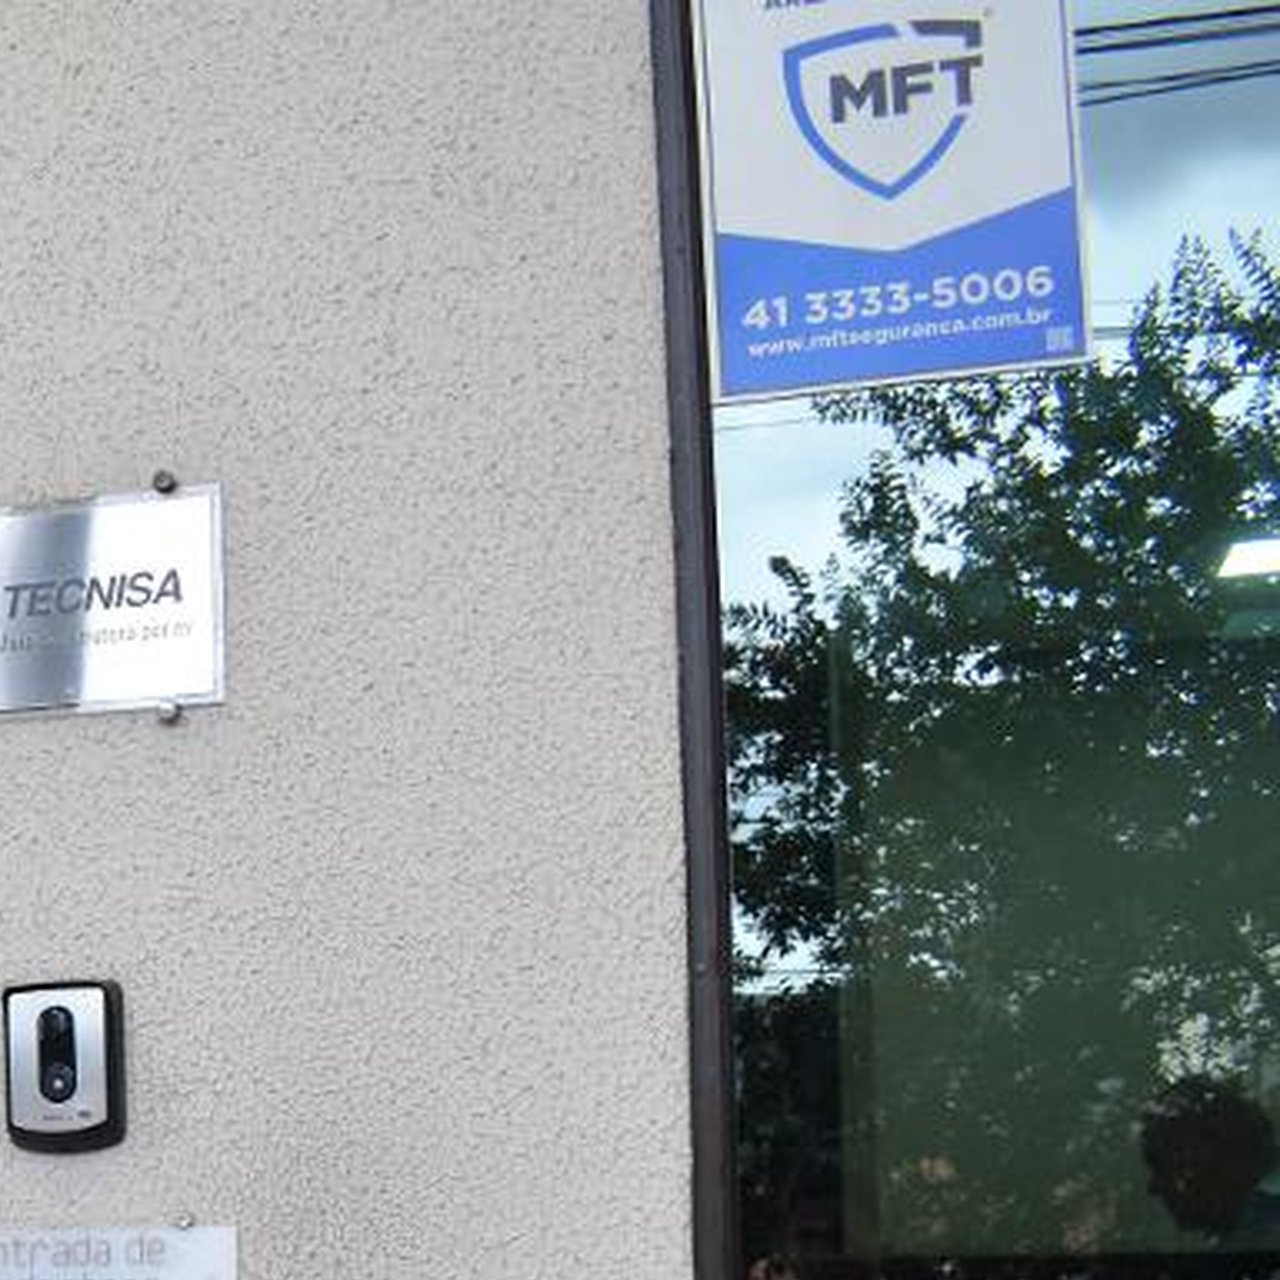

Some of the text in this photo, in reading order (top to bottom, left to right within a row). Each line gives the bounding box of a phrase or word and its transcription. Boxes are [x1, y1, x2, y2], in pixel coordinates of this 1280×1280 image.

[829, 53, 984, 124] MFT
[741, 265, 1056, 330] 41 3333-5006
[3, 568, 183, 619] TECNISA
[125, 1232, 166, 1266] de
